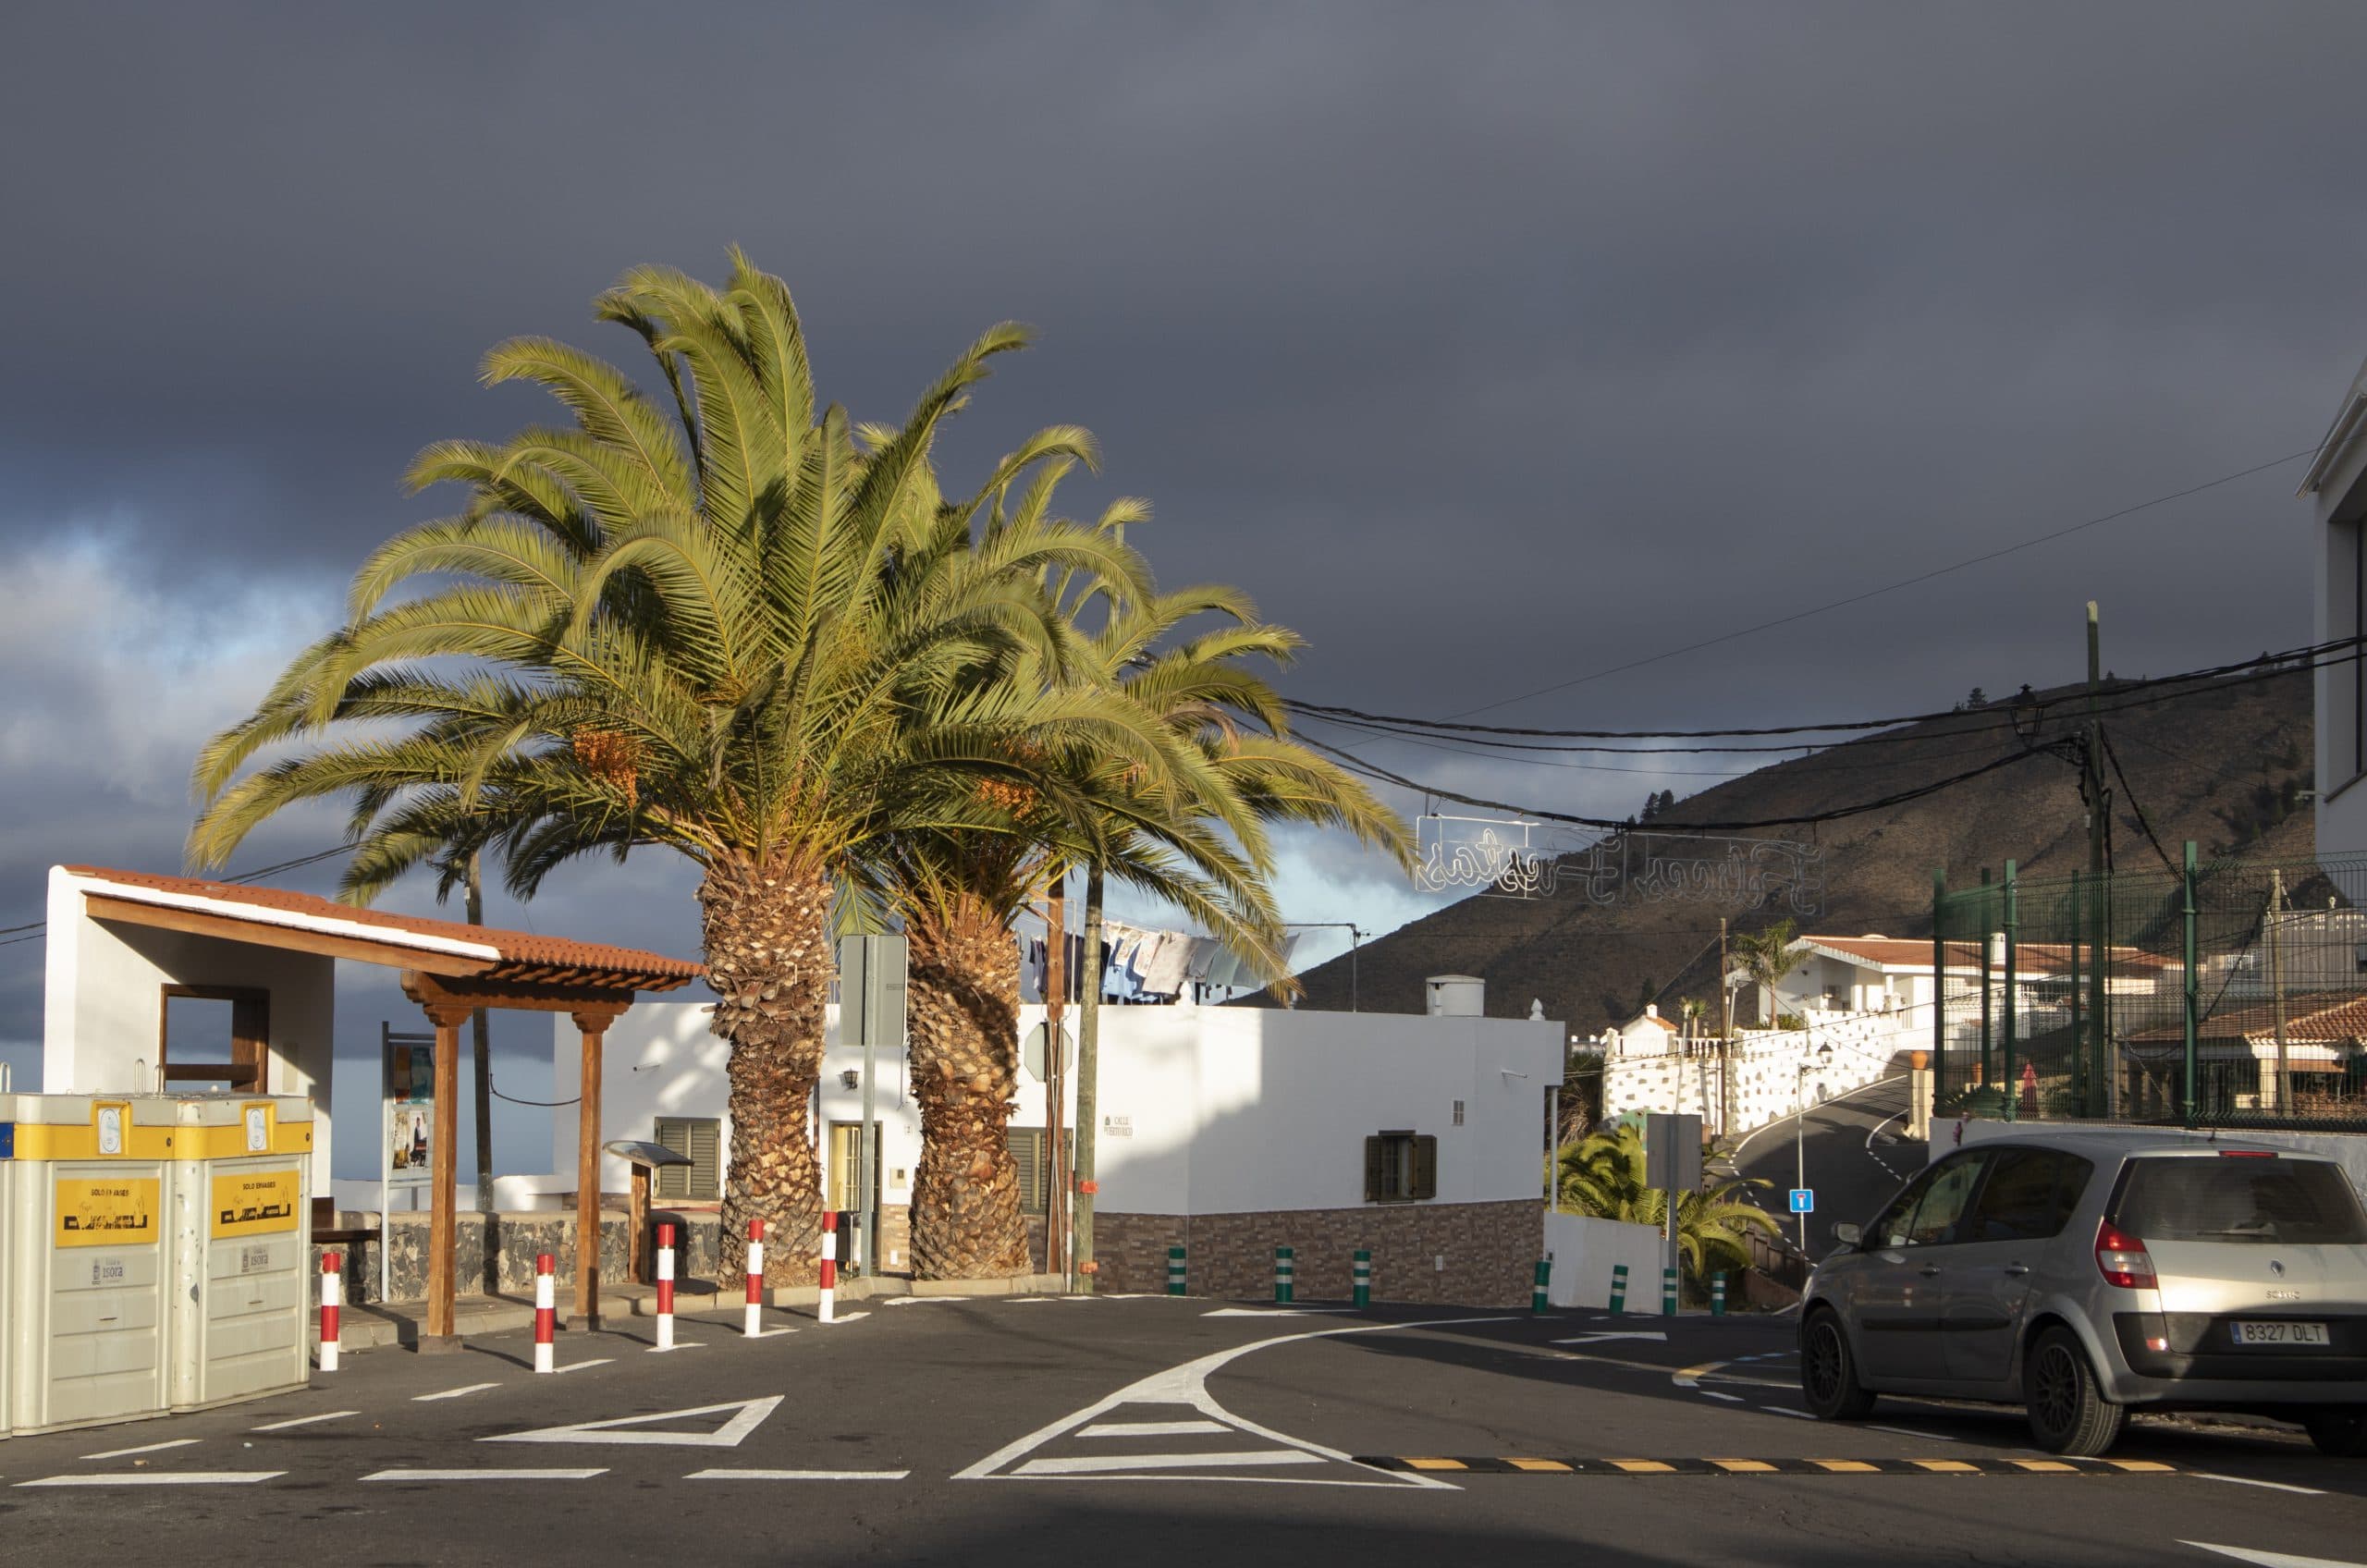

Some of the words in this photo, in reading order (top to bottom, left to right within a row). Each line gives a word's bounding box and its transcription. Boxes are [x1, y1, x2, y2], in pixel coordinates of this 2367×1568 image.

[242, 1182, 255, 1191] SOLO
[2244, 1323, 2286, 1341] 8327
[2292, 1323, 2322, 1342] DLT
